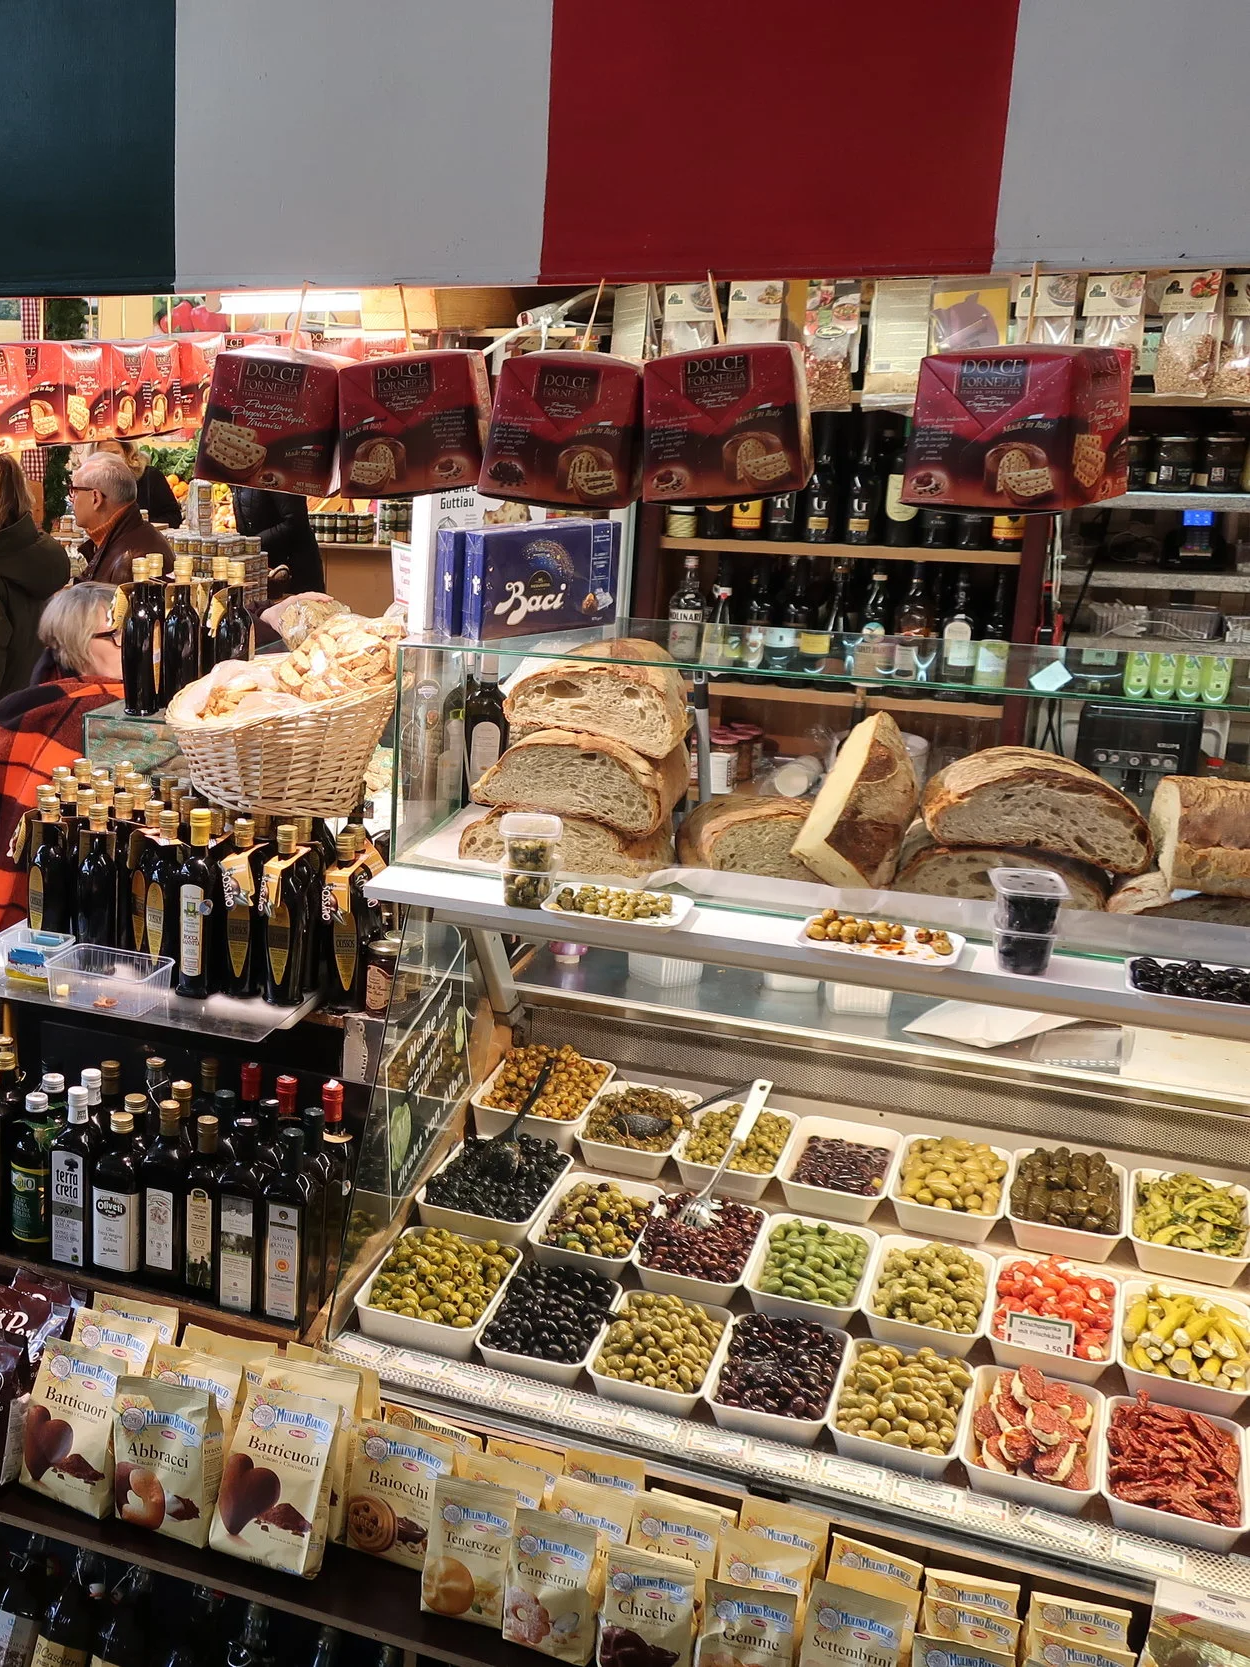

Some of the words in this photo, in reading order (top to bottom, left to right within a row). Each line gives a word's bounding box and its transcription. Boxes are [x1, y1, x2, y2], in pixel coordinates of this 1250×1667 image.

[245, 362, 302, 384] DOLCE
[377, 362, 427, 380] DOLCE
[687, 354, 744, 375] DOLCE
[962, 359, 1023, 376] DOLCE
[243, 378, 299, 396] FORNERIA
[377, 378, 429, 392] FORNERIA
[544, 374, 590, 391] DOLCE
[688, 372, 746, 387] FORNERIA
[961, 376, 1021, 388] FORNERIA
[543, 387, 589, 400] FORNERIA
[735, 413, 756, 426] Made
[765, 409, 782, 419] Italy
[1002, 423, 1024, 434] Made
[1025, 421, 1034, 429] in
[1035, 419, 1054, 431] Italy
[440, 497, 475, 510] Guttiau
[494, 580, 566, 626] Baci
[222, 870, 235, 908] OLYSSOS
[321, 884, 333, 921] OLYSSOS
[406, 1014, 437, 1067] Weiße
[438, 981, 453, 1019] und
[407, 1016, 450, 1093] schwarze
[415, 1047, 443, 1105] Trüffel
[397, 1138, 423, 1193] direkt
[425, 1106, 441, 1139] von
[443, 1071, 464, 1112] Alba
[56, 1168, 78, 1186] terra
[55, 1182, 78, 1200] creta
[97, 1200, 123, 1213] Oliveti
[272, 1235, 294, 1245] NATIVES
[102, 1328, 126, 1346] MULINO
[126, 1332, 146, 1352] BIANCO
[71, 1360, 97, 1378] MULINO
[97, 1365, 116, 1386] BIANCO
[181, 1374, 207, 1391] MULINO
[207, 1379, 229, 1399] BIANCO
[45, 1385, 108, 1420] Batticuori
[146, 1410, 174, 1426] MULINO
[173, 1416, 196, 1436] BIANCO
[276, 1408, 305, 1425] MULINO
[305, 1412, 329, 1434] BIANCO
[440, 1424, 467, 1444] BIANCO
[127, 1441, 189, 1469] Abbracci
[248, 1434, 322, 1468] Batticuori
[387, 1441, 417, 1458] MULINO
[416, 1446, 442, 1470] BIANCO
[262, 1454, 279, 1465] Cacao
[284, 1460, 312, 1474] Cioccolato
[369, 1469, 430, 1501] Baiocchi
[590, 1473, 613, 1486] MULINO
[612, 1476, 635, 1491] BIANCO
[461, 1507, 486, 1521] MULINO
[486, 1512, 508, 1529] BIANCO
[576, 1512, 600, 1527] MULINO
[599, 1517, 621, 1535] BIANCO
[444, 1530, 502, 1555] Tenerezze
[661, 1521, 686, 1536] MULINO
[685, 1525, 709, 1542] BIANCO
[766, 1528, 792, 1544] MULINO
[791, 1534, 816, 1552] BIANCO
[539, 1540, 563, 1554] MULINO
[563, 1543, 585, 1561] BIANCO
[517, 1561, 579, 1589] Canestrini
[751, 1566, 775, 1581] MULINO
[774, 1570, 798, 1589] BIANCO
[861, 1556, 888, 1571] MULINO
[887, 1562, 912, 1582] BIANCO
[633, 1575, 658, 1590] MULINO
[657, 1579, 683, 1594] BIANCO
[957, 1588, 983, 1605] MULINO
[982, 1594, 1009, 1611] BIANCO
[618, 1600, 676, 1623] Chicche
[737, 1601, 763, 1617] MULINO
[762, 1605, 788, 1624] BIANCO
[1065, 1608, 1095, 1626] MULINO
[1094, 1613, 1121, 1633] BIANCO
[840, 1611, 868, 1628] MULINO
[867, 1617, 894, 1639] BIANCO
[957, 1610, 985, 1628] MULINO
[984, 1617, 1010, 1638] BIANCO
[722, 1627, 780, 1652] Gemme
[812, 1634, 893, 1667] Settembrini
[1067, 1649, 1096, 1667] MULINO
